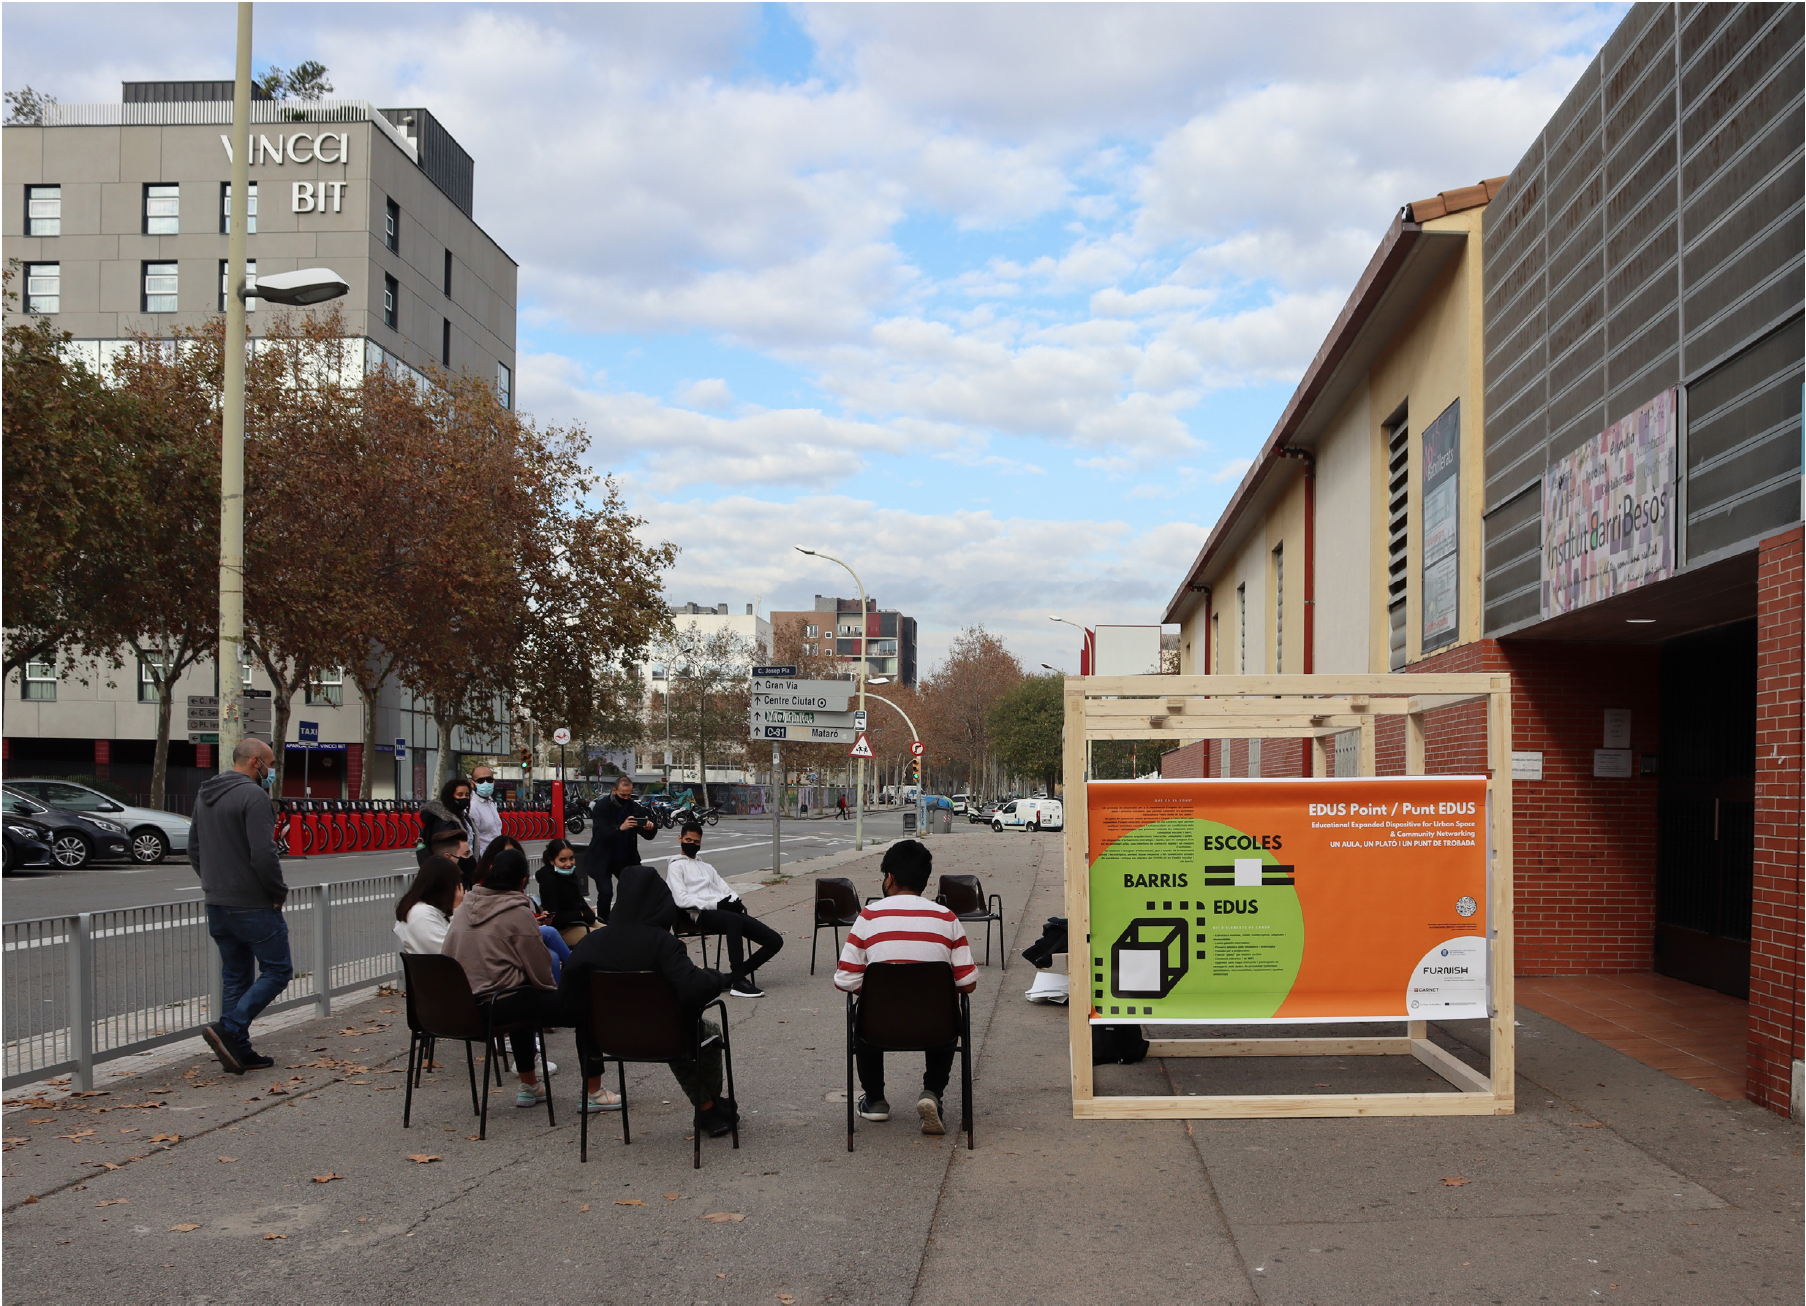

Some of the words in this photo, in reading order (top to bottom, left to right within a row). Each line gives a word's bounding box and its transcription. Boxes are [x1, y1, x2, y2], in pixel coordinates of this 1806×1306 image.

[292, 181, 347, 213] BIT
[1548, 524, 1588, 570] Institut
[765, 667, 780, 675] Josep
[765, 681, 784, 690] Gran
[786, 681, 798, 690] Via
[764, 695, 789, 705] Centre
[791, 696, 815, 706] Ciutat
[300, 727, 318, 736] TAXI
[811, 729, 839, 738] Mataró
[1308, 803, 1346, 816] EDUS
[1350, 802, 1387, 816] Point
[1390, 802, 1399, 817] /
[1402, 802, 1435, 815] Punt
[1438, 802, 1476, 815] EDUS
[1311, 821, 1350, 829] Educational
[1351, 821, 1385, 830] Expanded
[1386, 821, 1421, 829] Dispositive
[1455, 821, 1476, 829] Space
[1396, 830, 1435, 838] Community
[1436, 830, 1476, 838] Networking
[1204, 834, 1283, 851] ESCOLES
[1375, 839, 1398, 847] PLATÓ
[1124, 873, 1188, 888] BARRIS
[1213, 899, 1259, 915] EDUS
[1423, 966, 1468, 974] FURNISH
